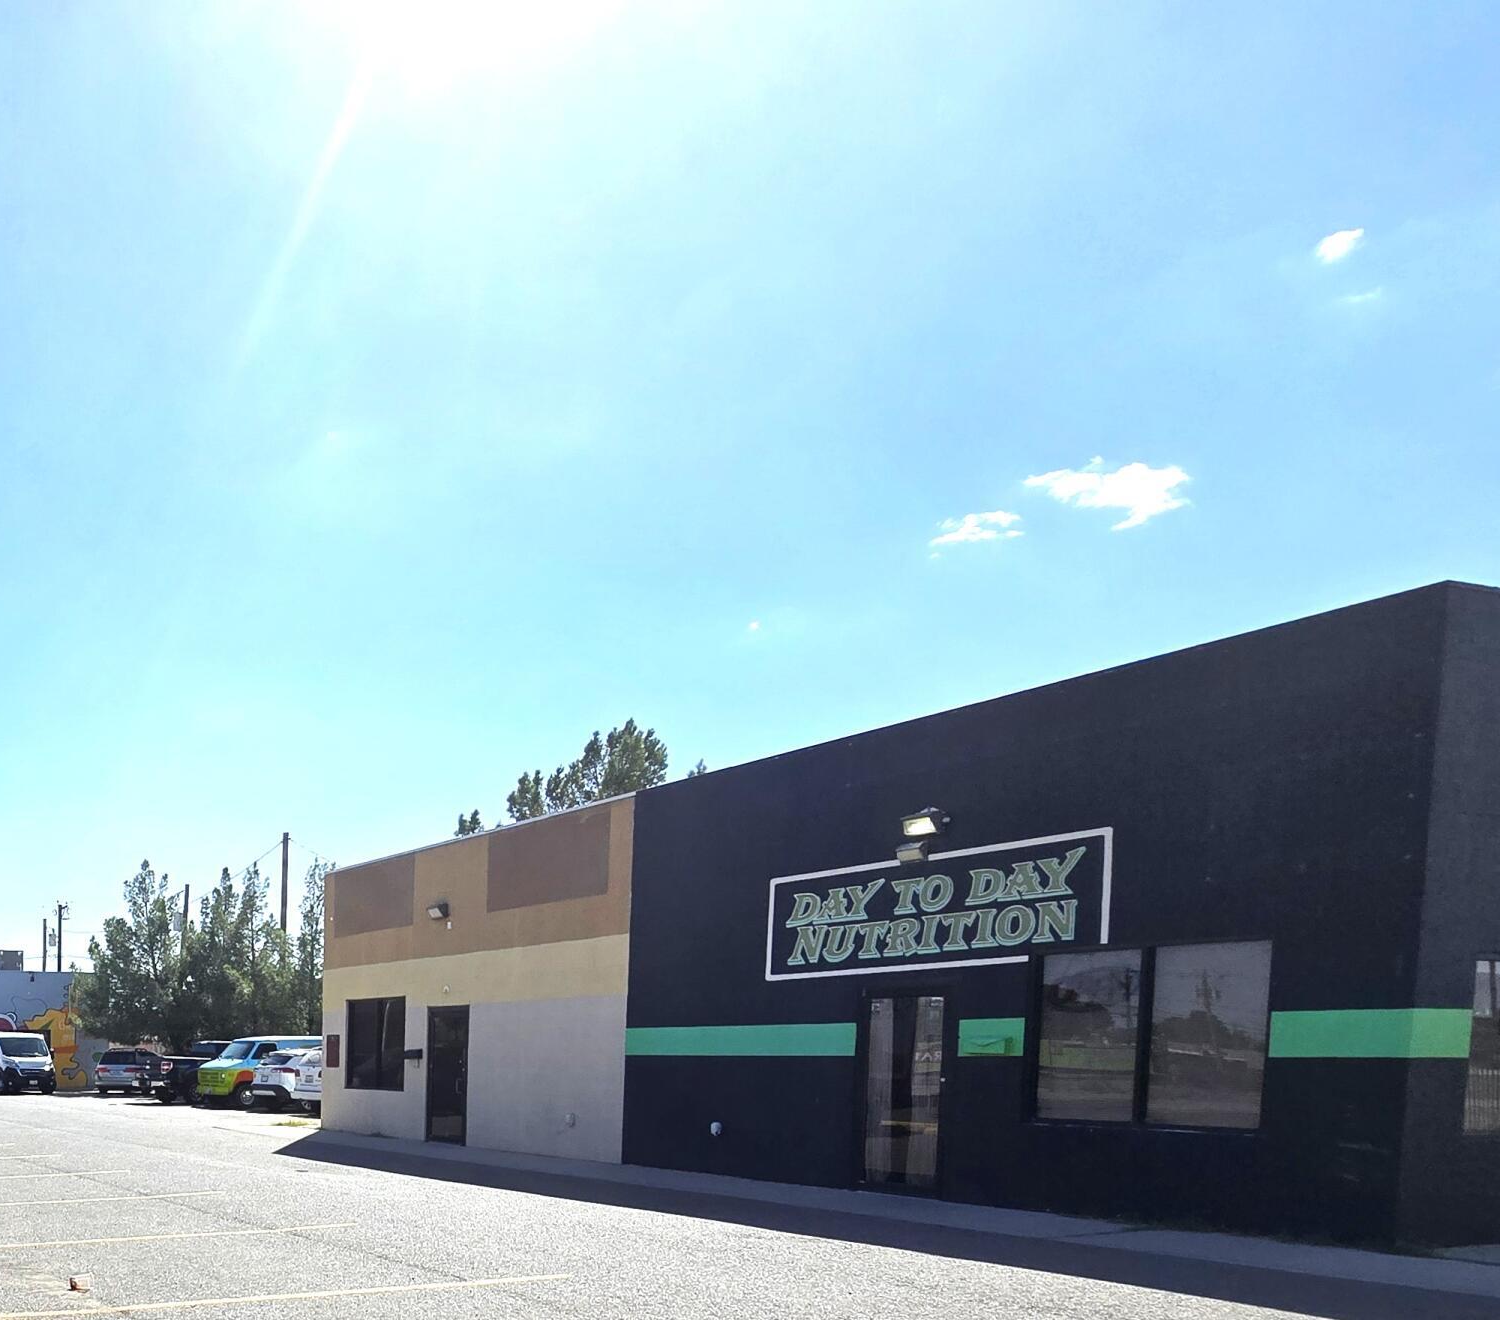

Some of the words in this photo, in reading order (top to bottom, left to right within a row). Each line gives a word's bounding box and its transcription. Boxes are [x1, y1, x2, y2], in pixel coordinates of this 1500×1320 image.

[786, 878, 886, 928] DAY
[891, 874, 954, 915] TO
[964, 846, 1087, 906] DAY
[787, 899, 1079, 966] NUTRITION
